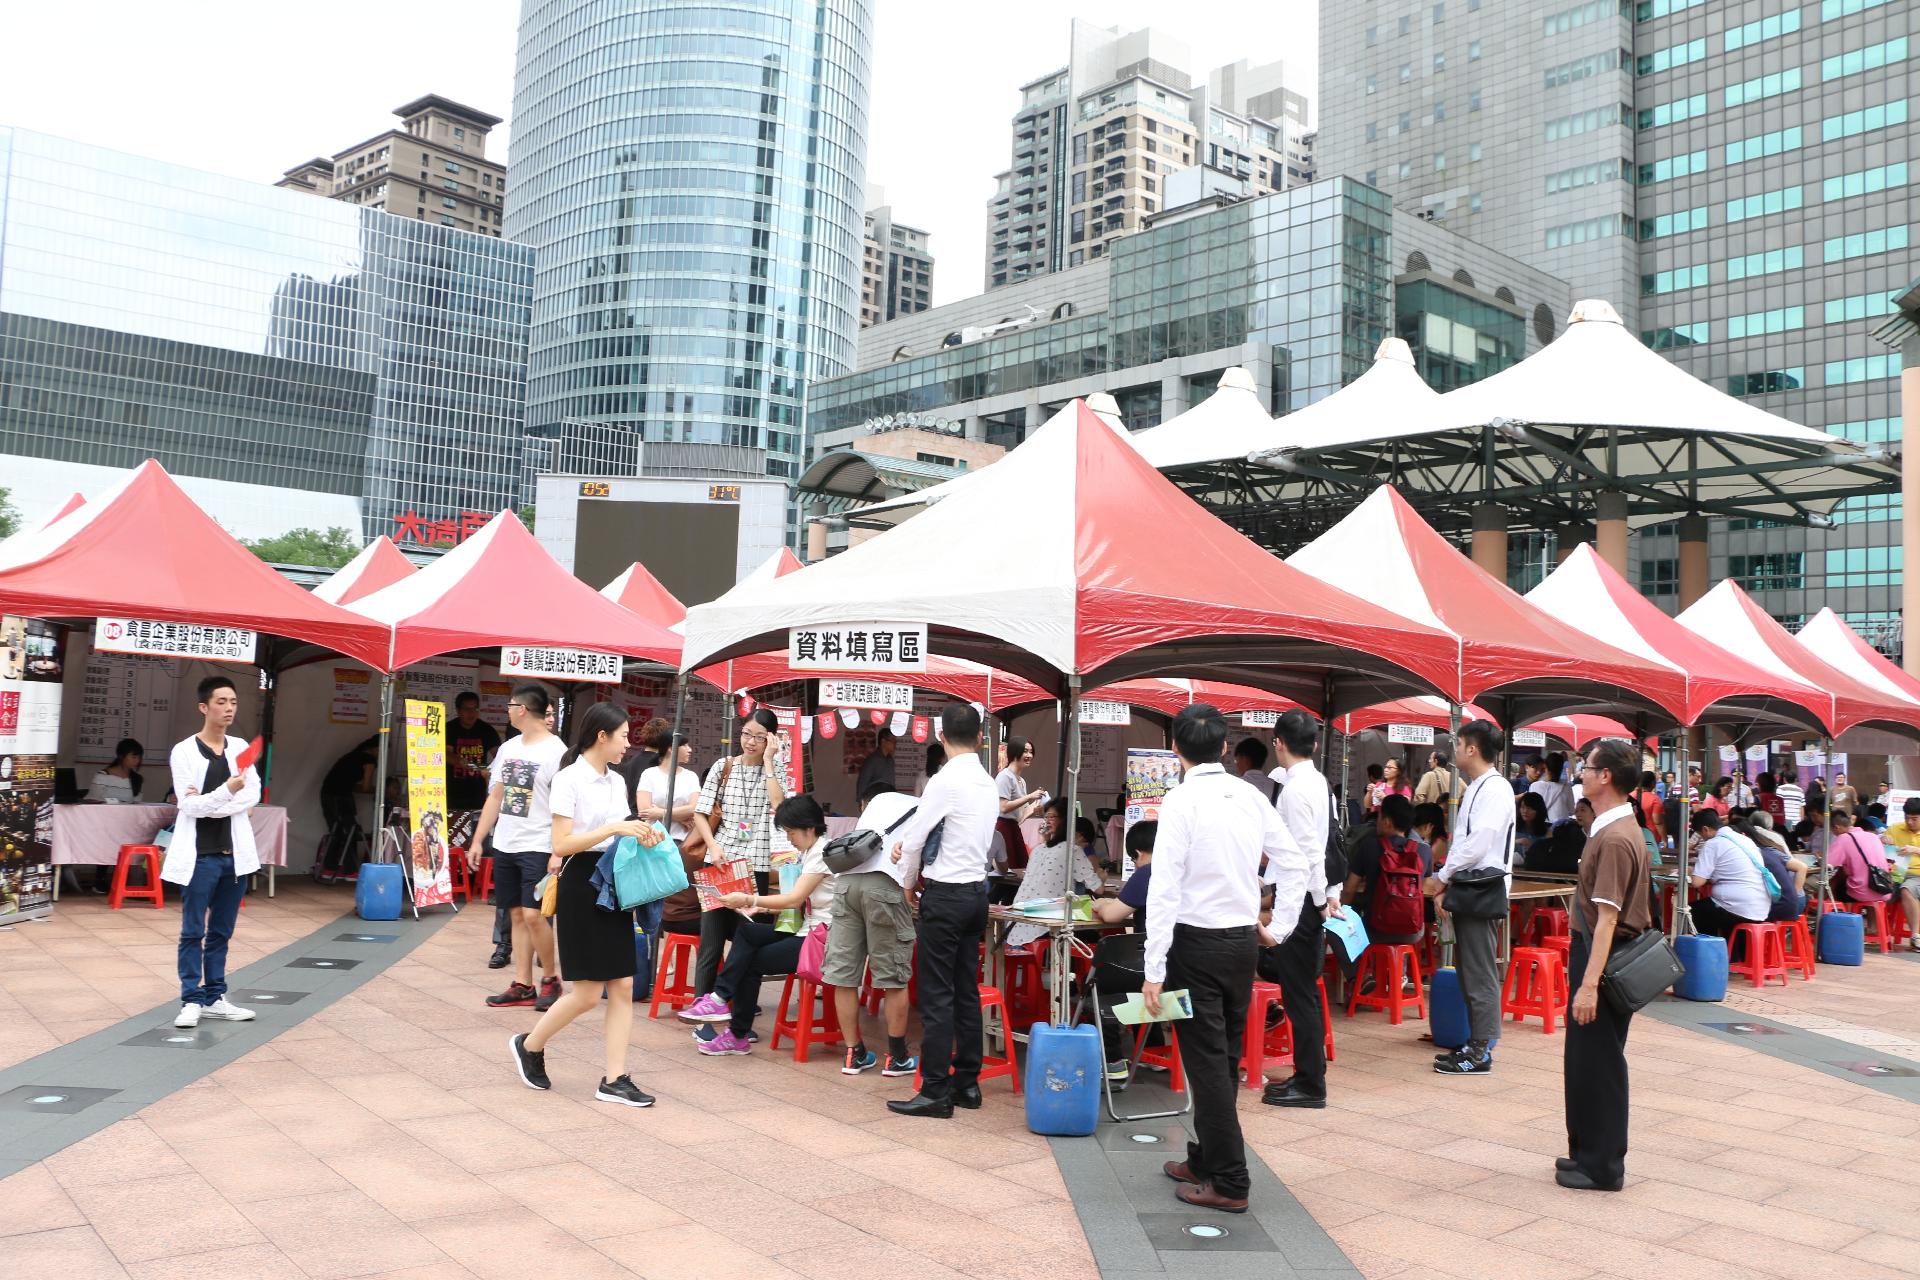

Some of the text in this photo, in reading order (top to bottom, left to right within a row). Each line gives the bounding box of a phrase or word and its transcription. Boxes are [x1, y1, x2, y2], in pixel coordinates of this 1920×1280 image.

[104, 620, 250, 647] 08 食昌企業股份有限公司
[797, 631, 920, 662] 資料填寫區
[507, 652, 520, 665] 07
